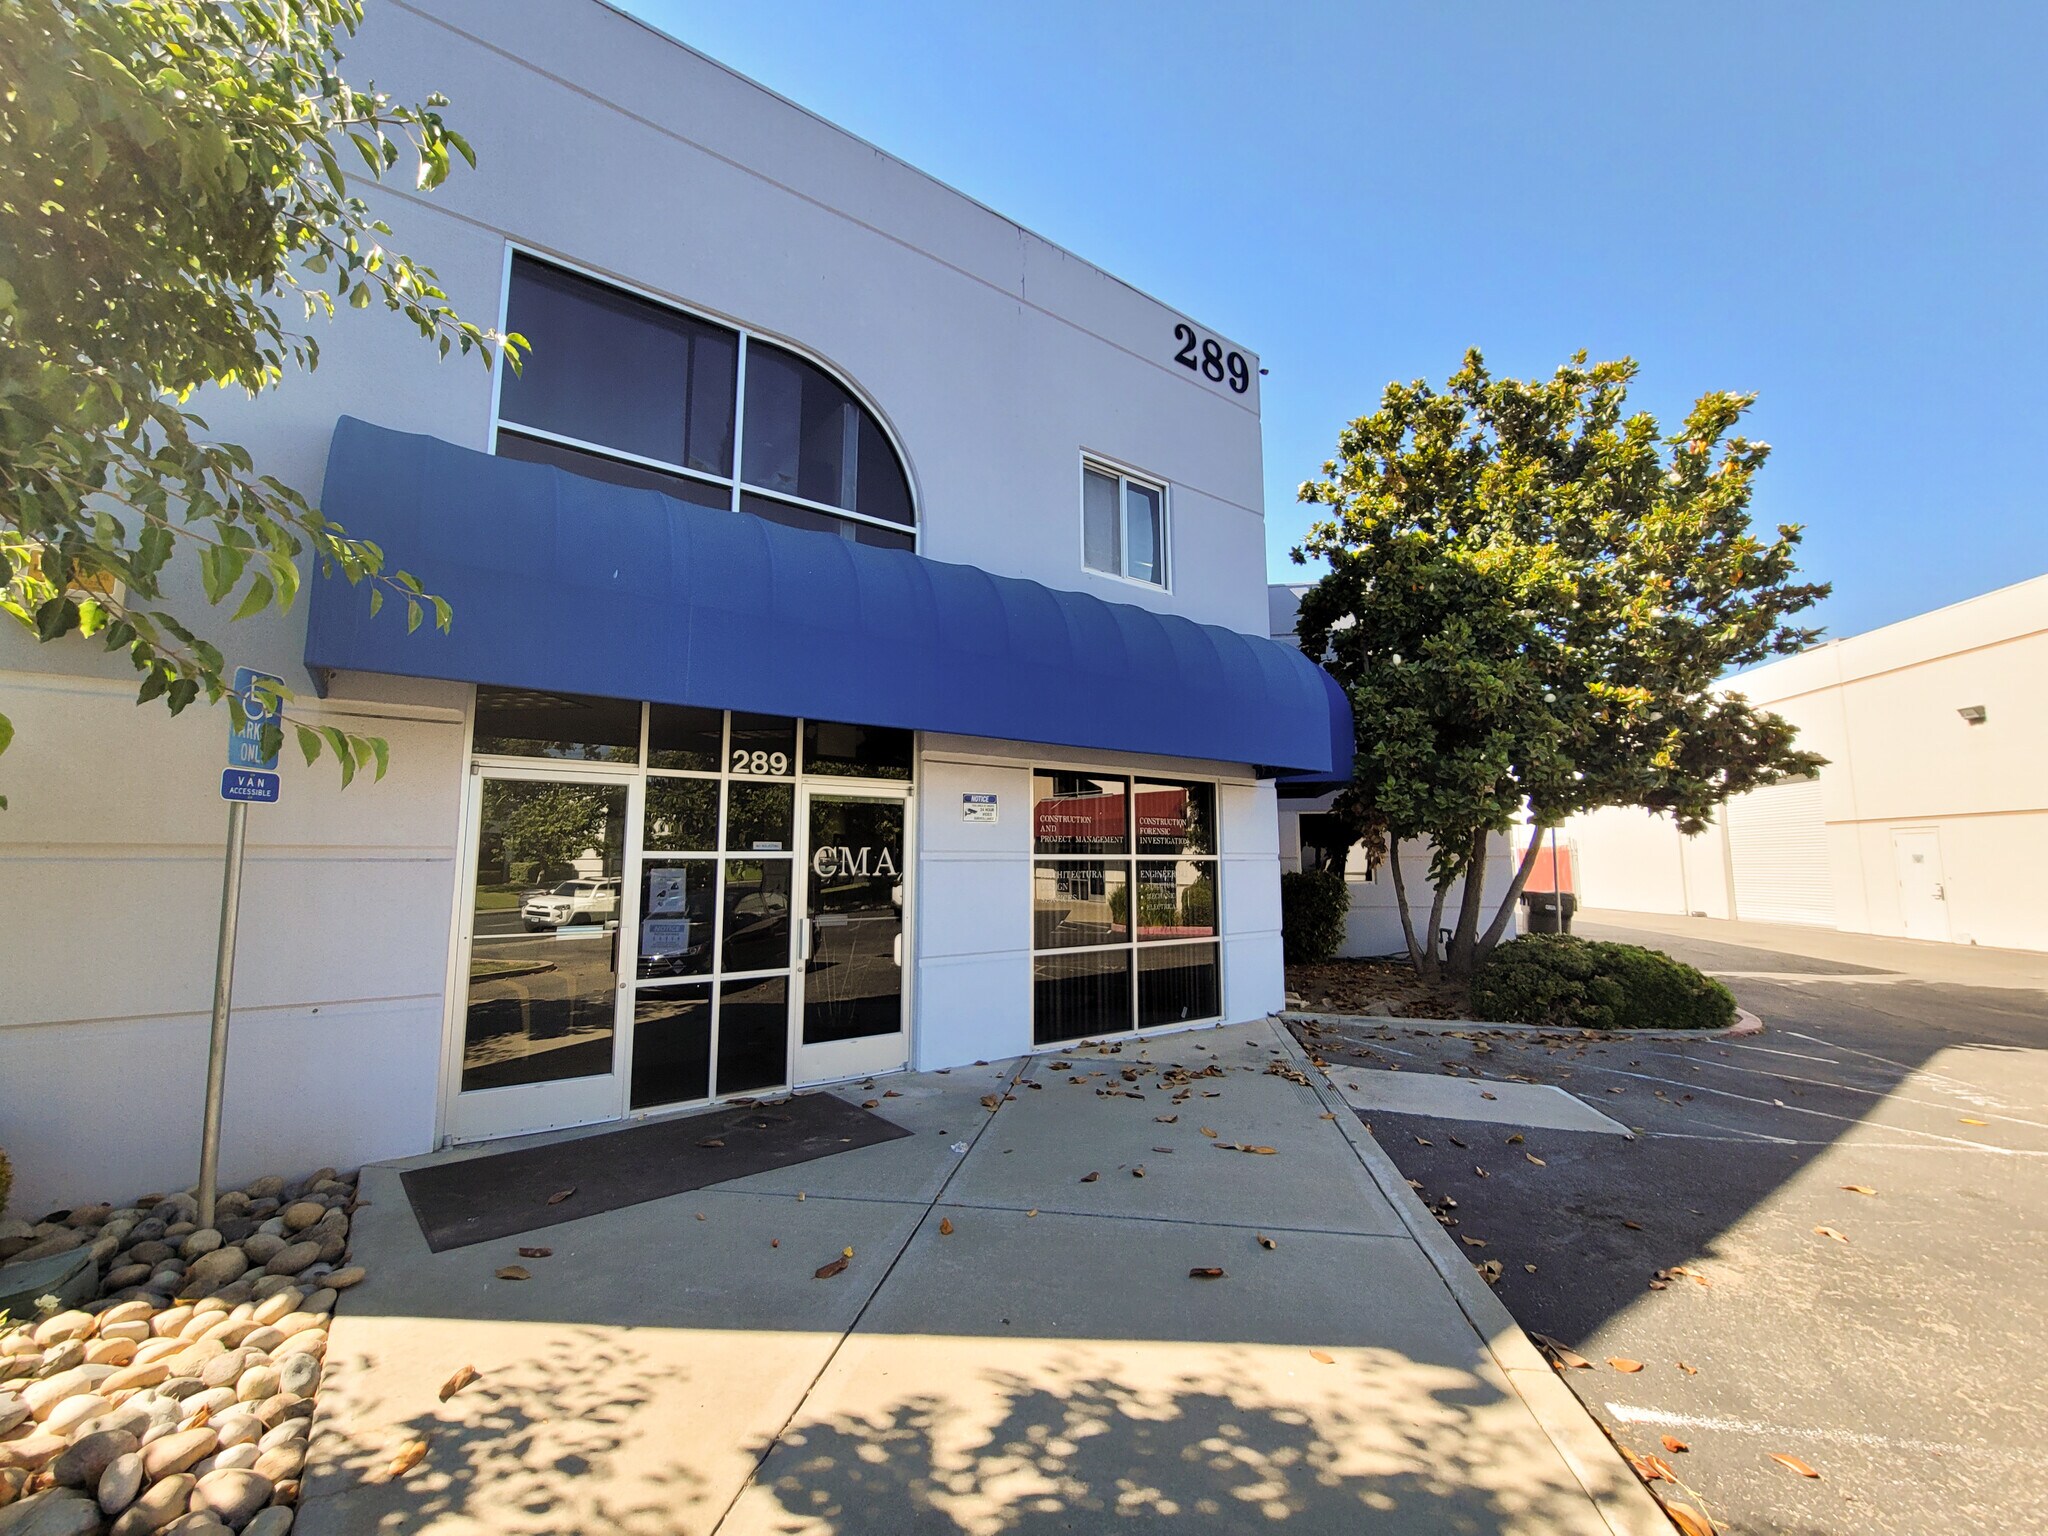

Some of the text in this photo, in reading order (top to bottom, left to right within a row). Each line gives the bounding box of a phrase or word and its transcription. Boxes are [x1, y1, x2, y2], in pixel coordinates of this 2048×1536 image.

[1174, 323, 1249, 394] 289
[240, 742, 264, 764] ONL
[732, 749, 788, 776] 289
[238, 776, 265, 788] VAN
[229, 786, 272, 797] ACCESSIBLE
[970, 795, 990, 803] NOTICE
[1039, 814, 1092, 824] CONSTRUCTION
[1139, 816, 1187, 826] CONSTRUCTION
[1039, 824, 1057, 833] AND
[1139, 827, 1171, 835] FORENSIC
[1039, 835, 1124, 843] PROJECT MANAGEMENT
[813, 846, 899, 877] CMA
